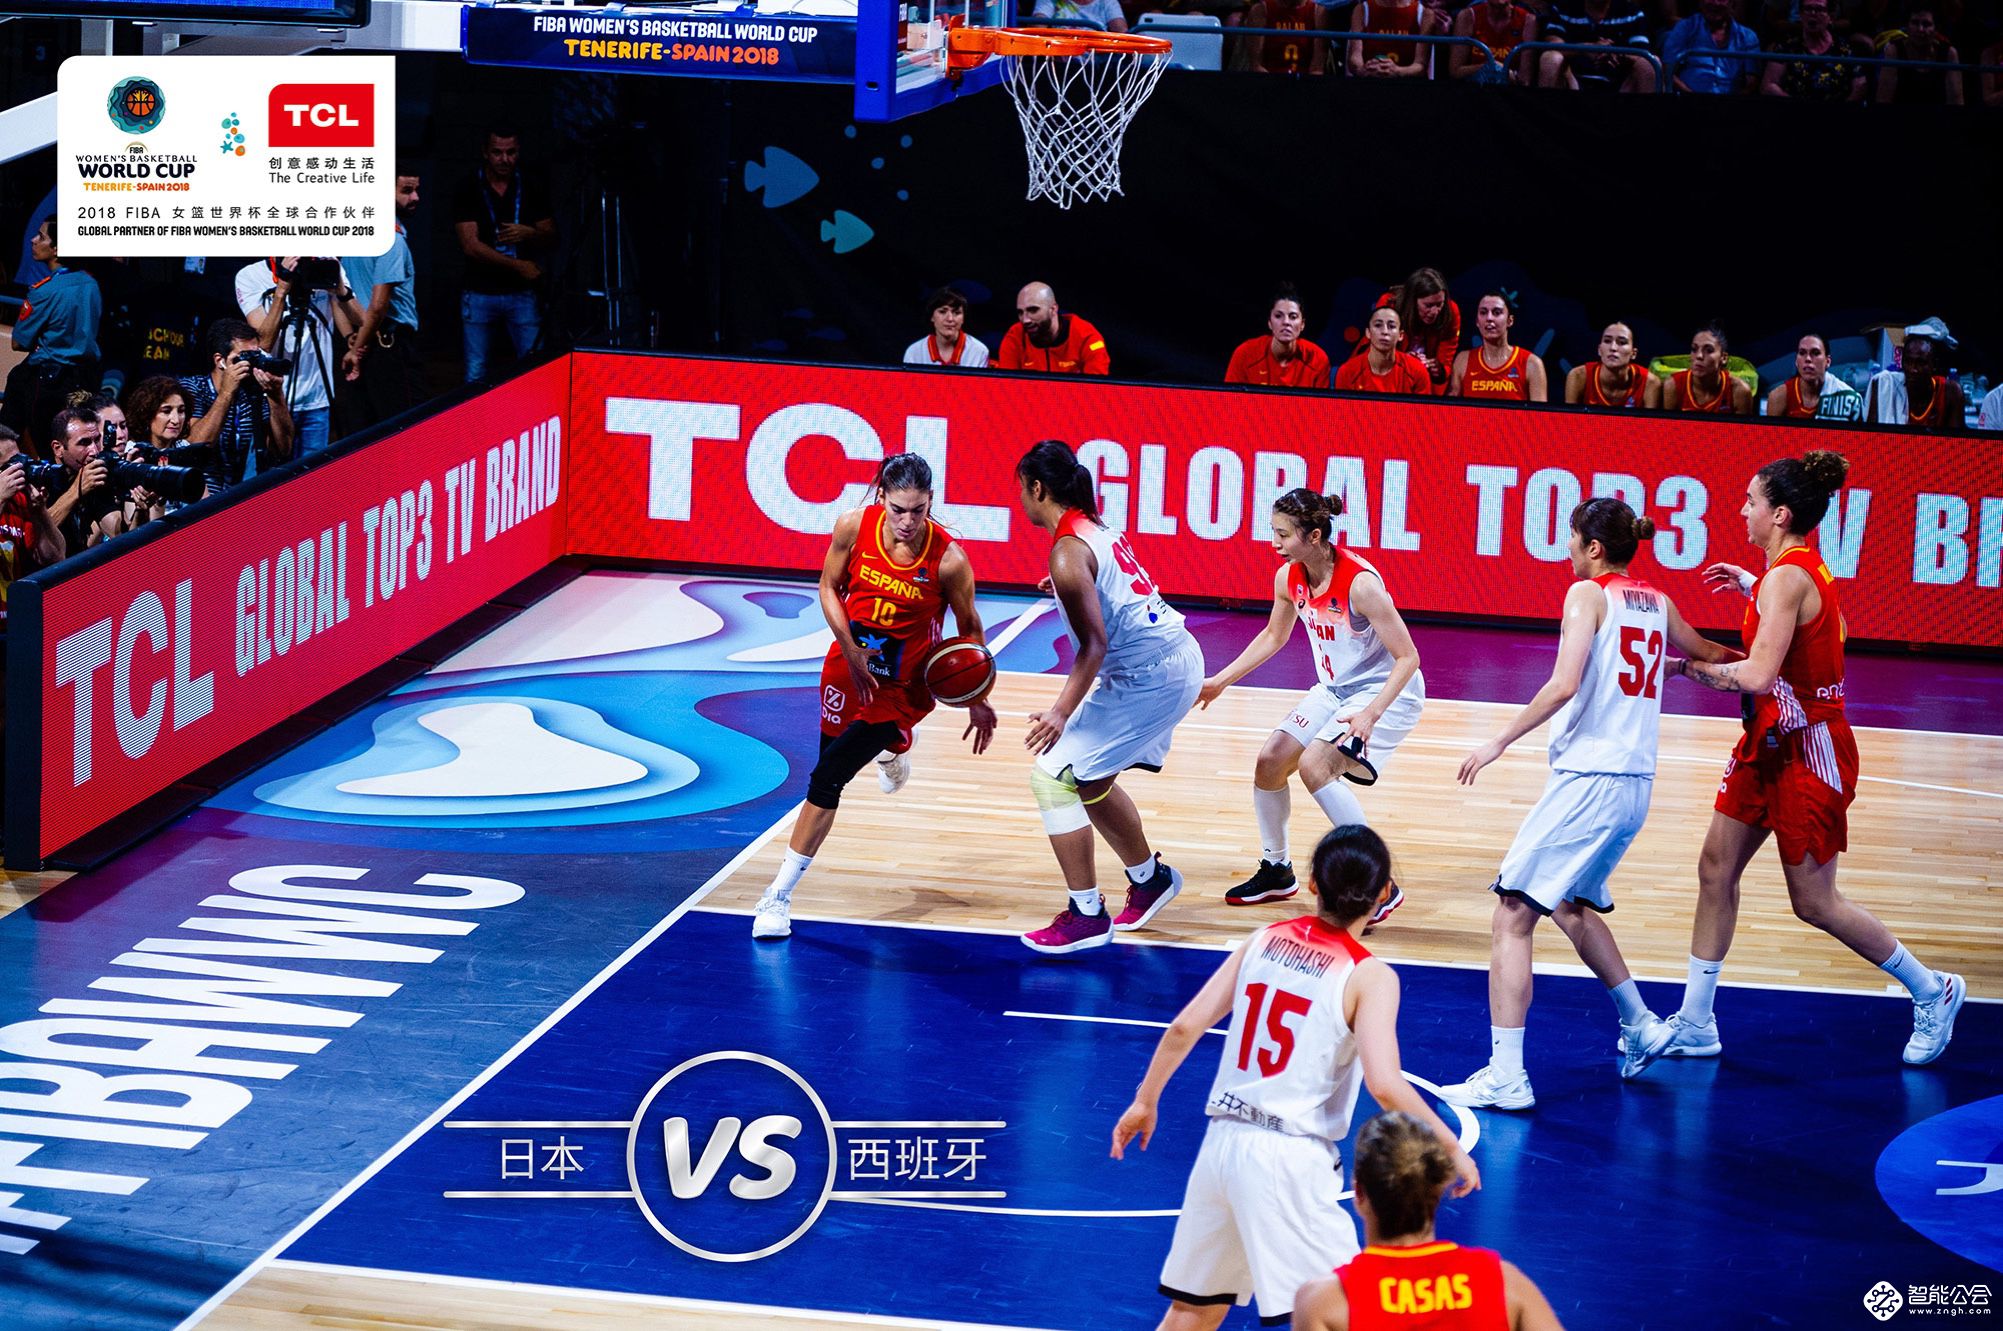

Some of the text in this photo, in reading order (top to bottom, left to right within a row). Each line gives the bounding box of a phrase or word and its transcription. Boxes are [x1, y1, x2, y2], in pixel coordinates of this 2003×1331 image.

[534, 17, 818, 43] FIBA WOMEN'S BASKETBALL WORLD CUP
[732, 47, 779, 65] 2018
[1471, 379, 1518, 392] ESPAÑA
[605, 397, 1010, 542] TCL
[1076, 438, 1421, 551] GLOBAL
[1816, 489, 1872, 579] V
[859, 565, 924, 600] ESPAÑA
[55, 416, 561, 788] TCL GLOBAL TOP3 TV BRAND
[871, 597, 896, 626] 10
[1308, 616, 1335, 641] JAN
[867, 663, 891, 677] Bank
[1618, 626, 1663, 700] 52
[1292, 714, 1309, 728] SU
[1260, 935, 1335, 980] MOTOHASHI
[1237, 983, 1312, 1079] 15
[0, 865, 526, 1256] FIBAWWC
[1212, 1092, 1285, 1133] 井不動産
[1379, 1274, 1472, 1314] CASAS
